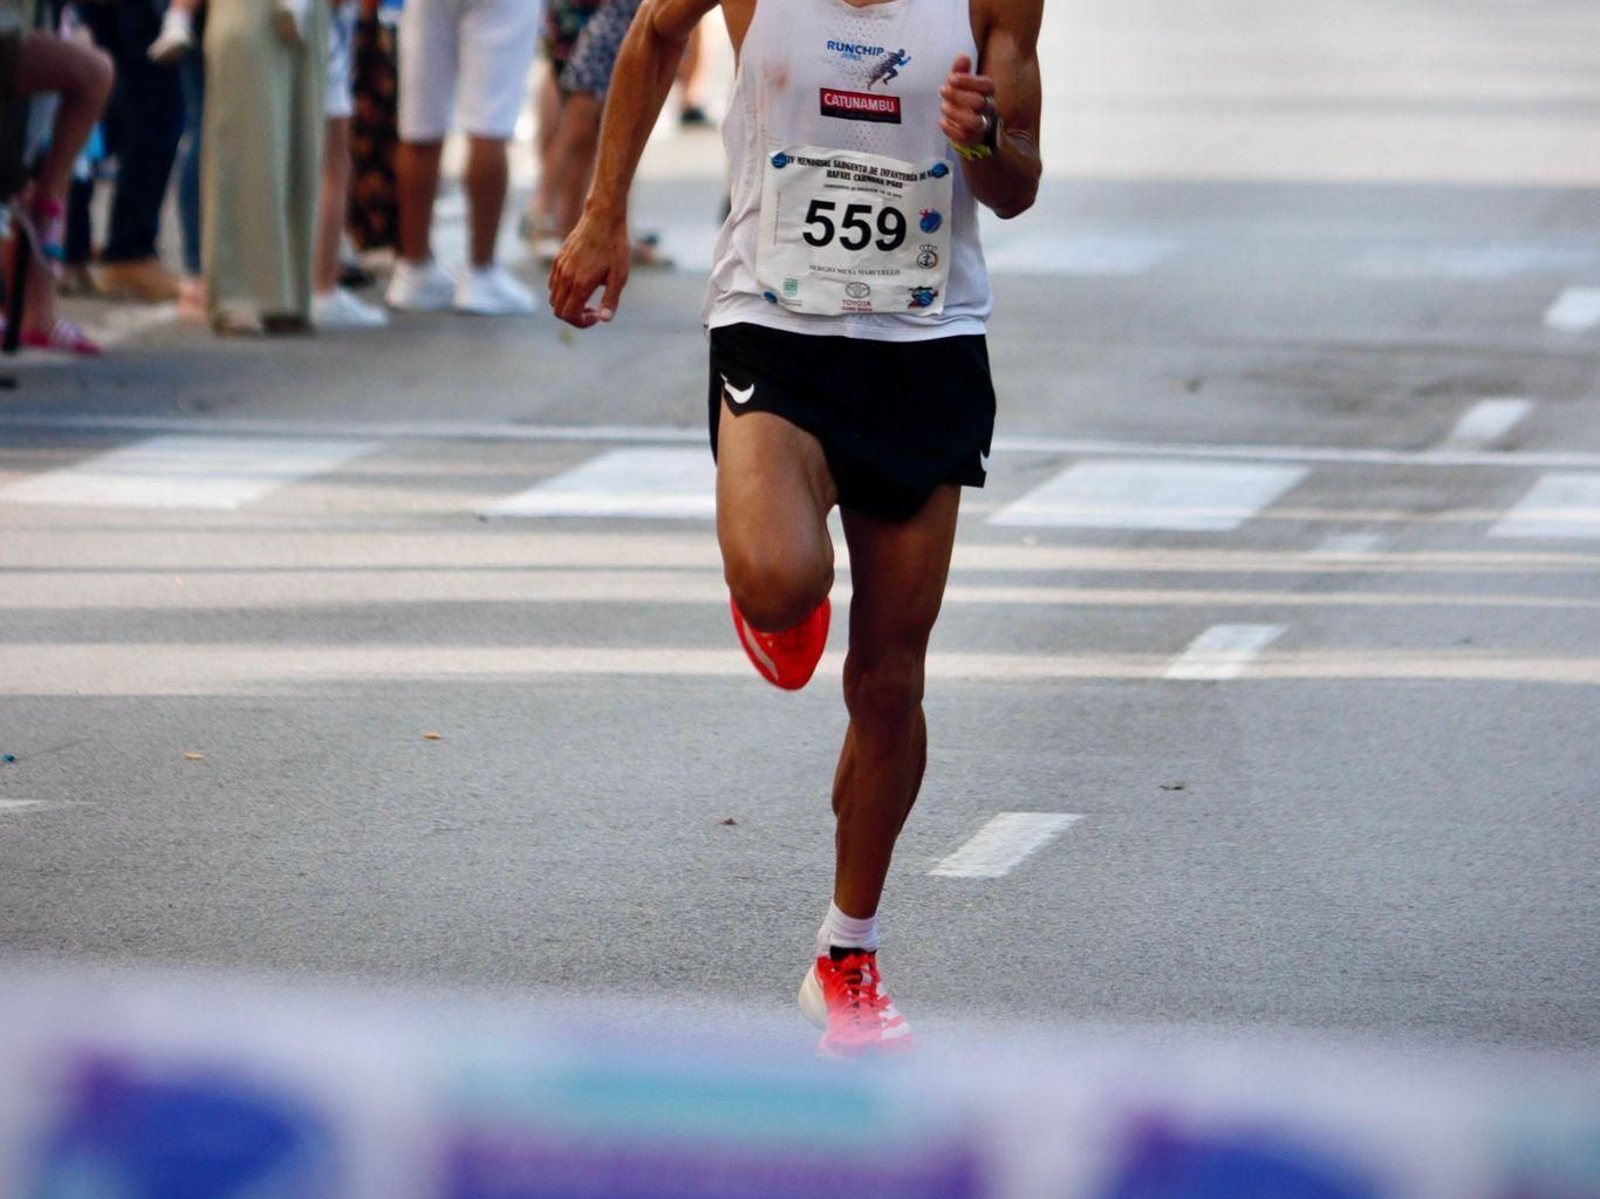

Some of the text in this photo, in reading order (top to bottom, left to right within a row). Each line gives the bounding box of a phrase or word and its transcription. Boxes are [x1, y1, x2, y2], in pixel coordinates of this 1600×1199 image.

[827, 40, 884, 56] RUNCHIP
[833, 158, 868, 174] SARGENTO
[802, 199, 907, 252] 559
[842, 299, 872, 307] TOYOTA
